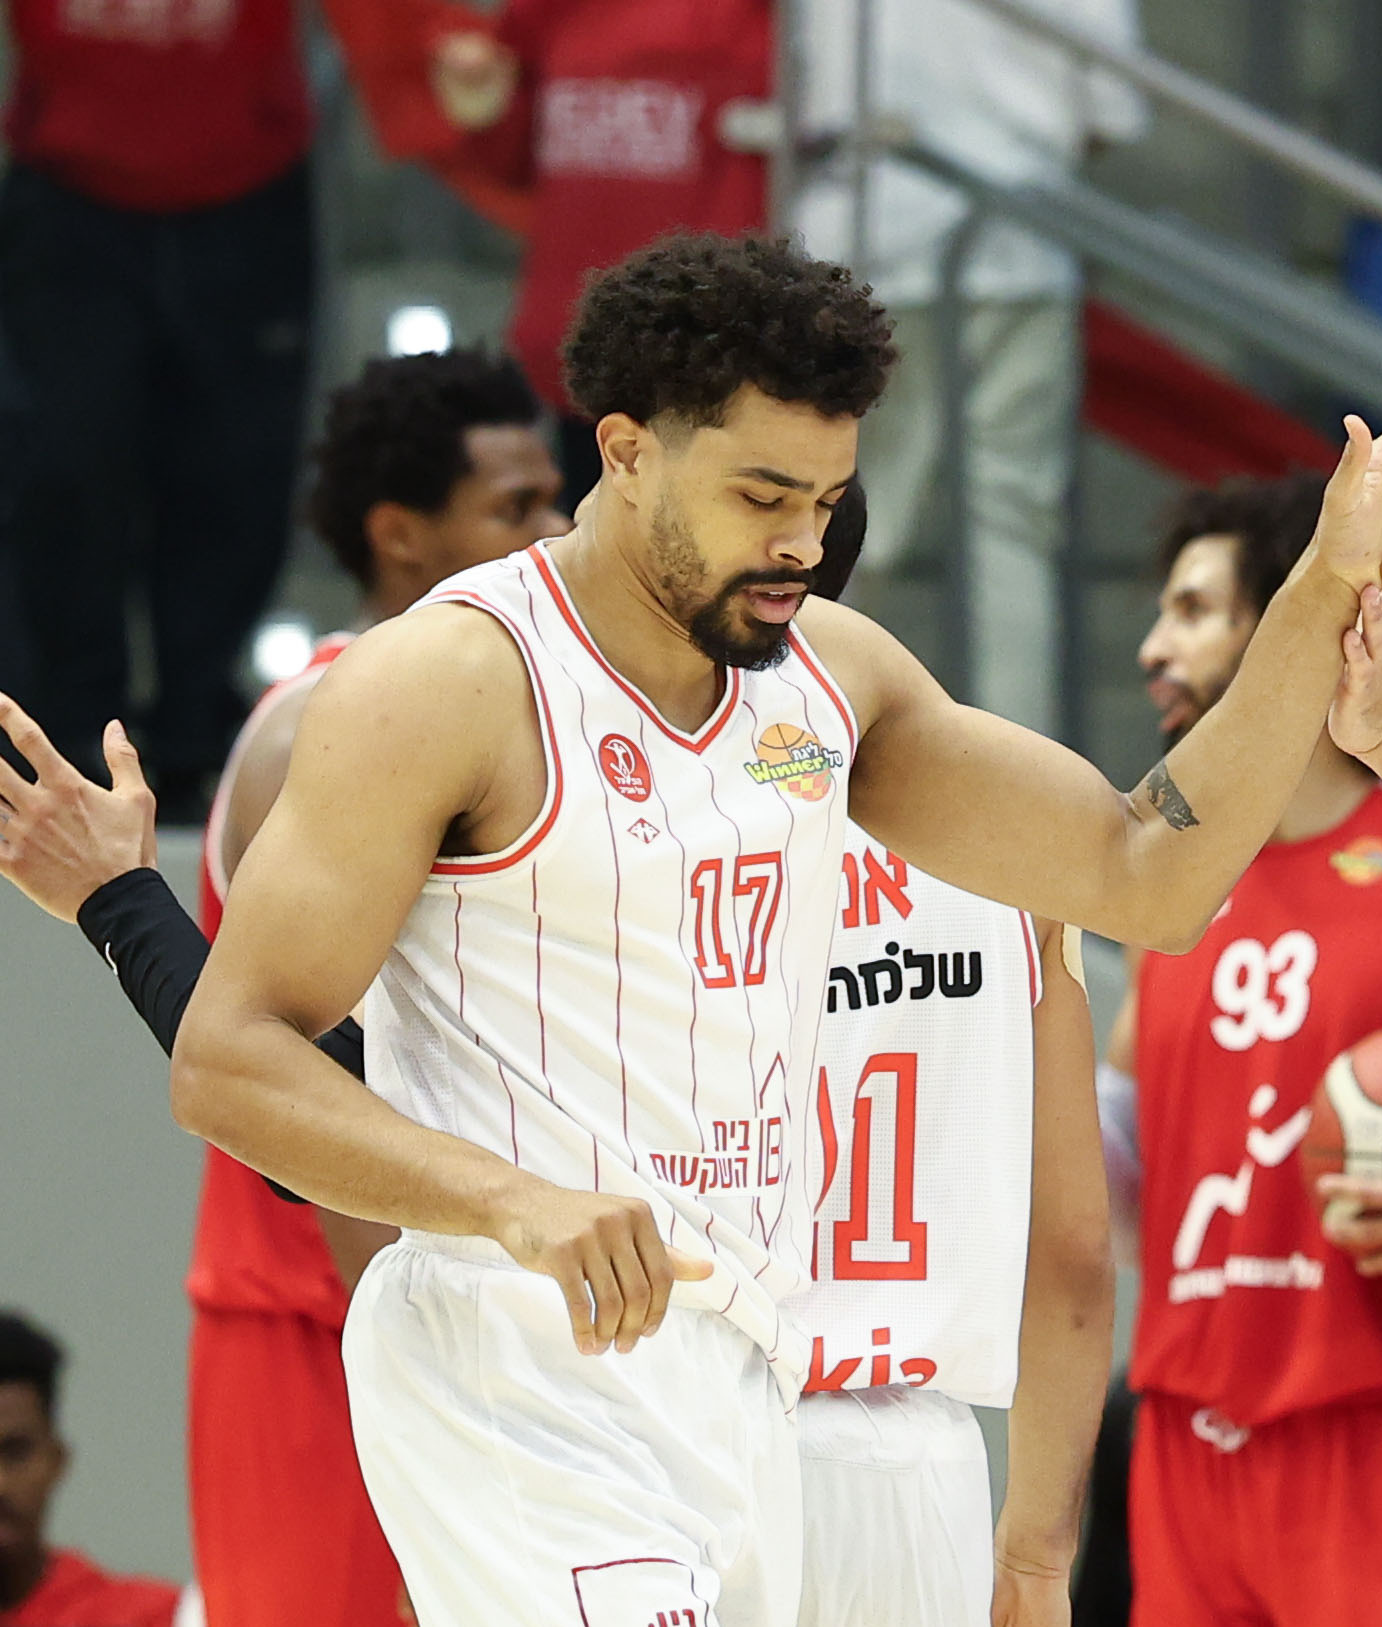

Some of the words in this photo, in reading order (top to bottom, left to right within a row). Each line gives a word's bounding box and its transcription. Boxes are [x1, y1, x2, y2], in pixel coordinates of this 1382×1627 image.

[743, 756, 824, 784] Winner
[690, 851, 783, 989] 17
[1210, 929, 1318, 1051] 93
[712, 1120, 750, 1152] בית
[649, 1153, 748, 1194] השקעות
